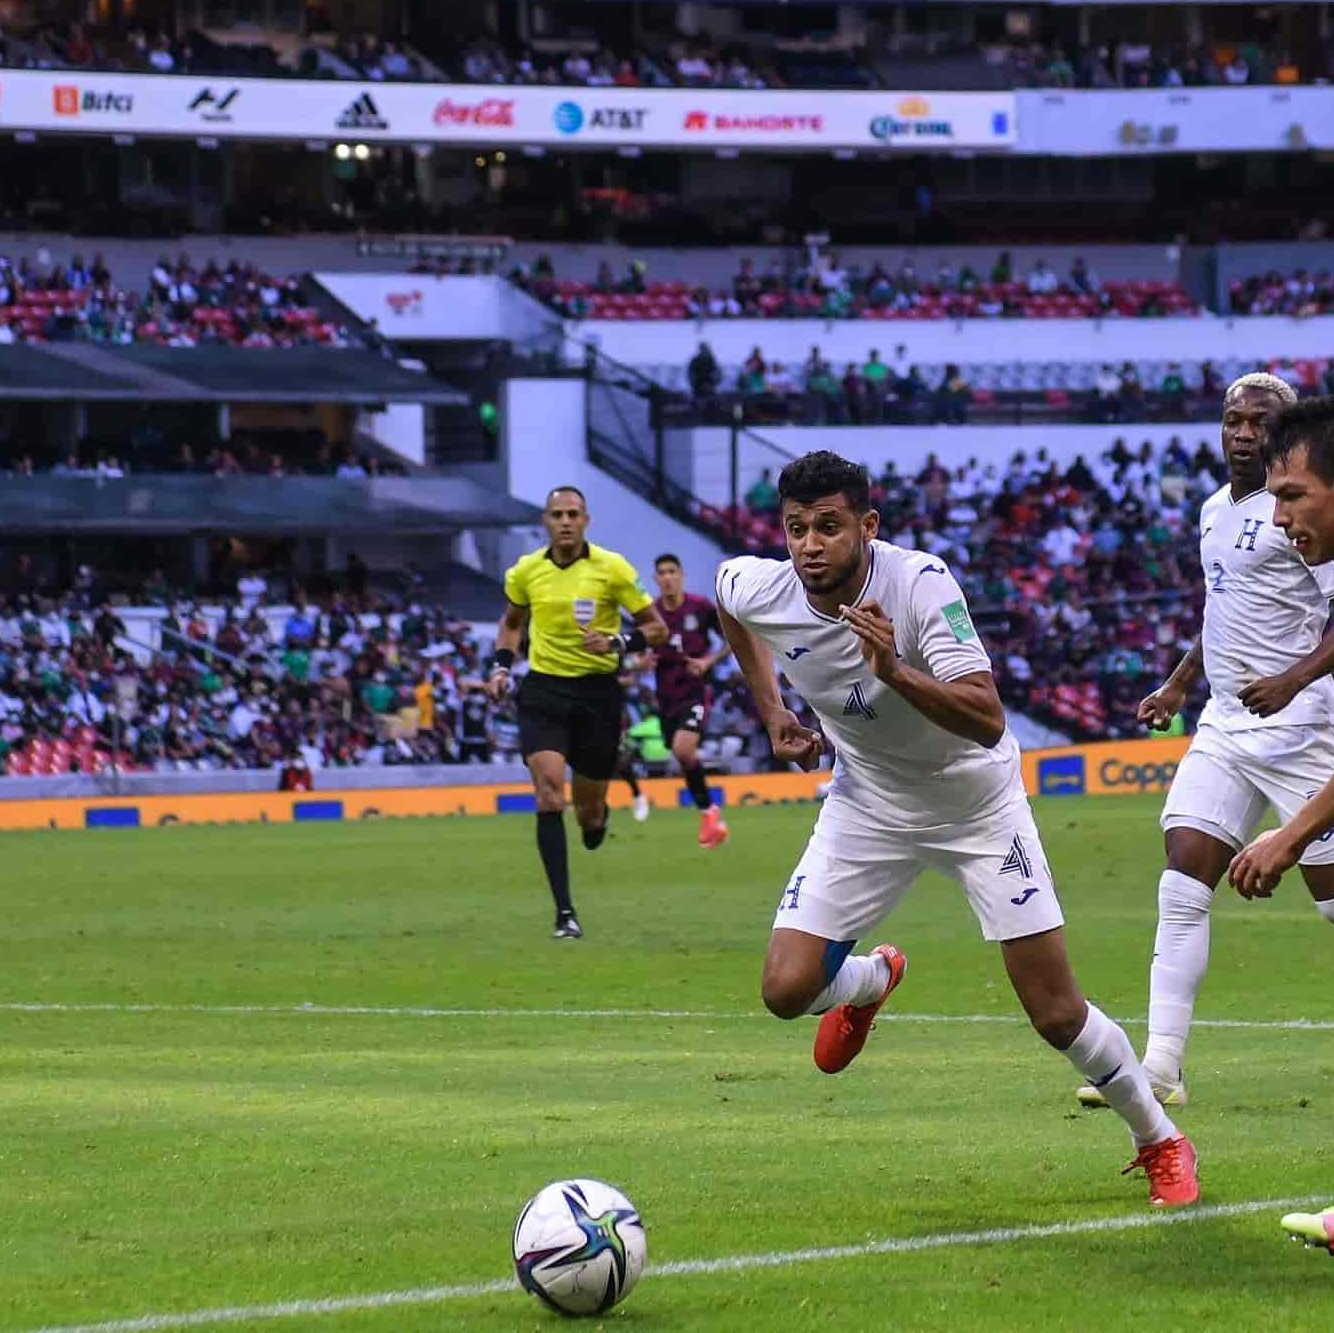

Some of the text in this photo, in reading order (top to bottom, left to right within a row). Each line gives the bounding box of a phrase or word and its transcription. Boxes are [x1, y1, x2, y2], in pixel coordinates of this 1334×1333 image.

[590, 108, 647, 131] AT&T
[1234, 518, 1265, 552] H
[1211, 558, 1228, 593] 2
[843, 681, 879, 721] 4
[999, 833, 1034, 879] 4
